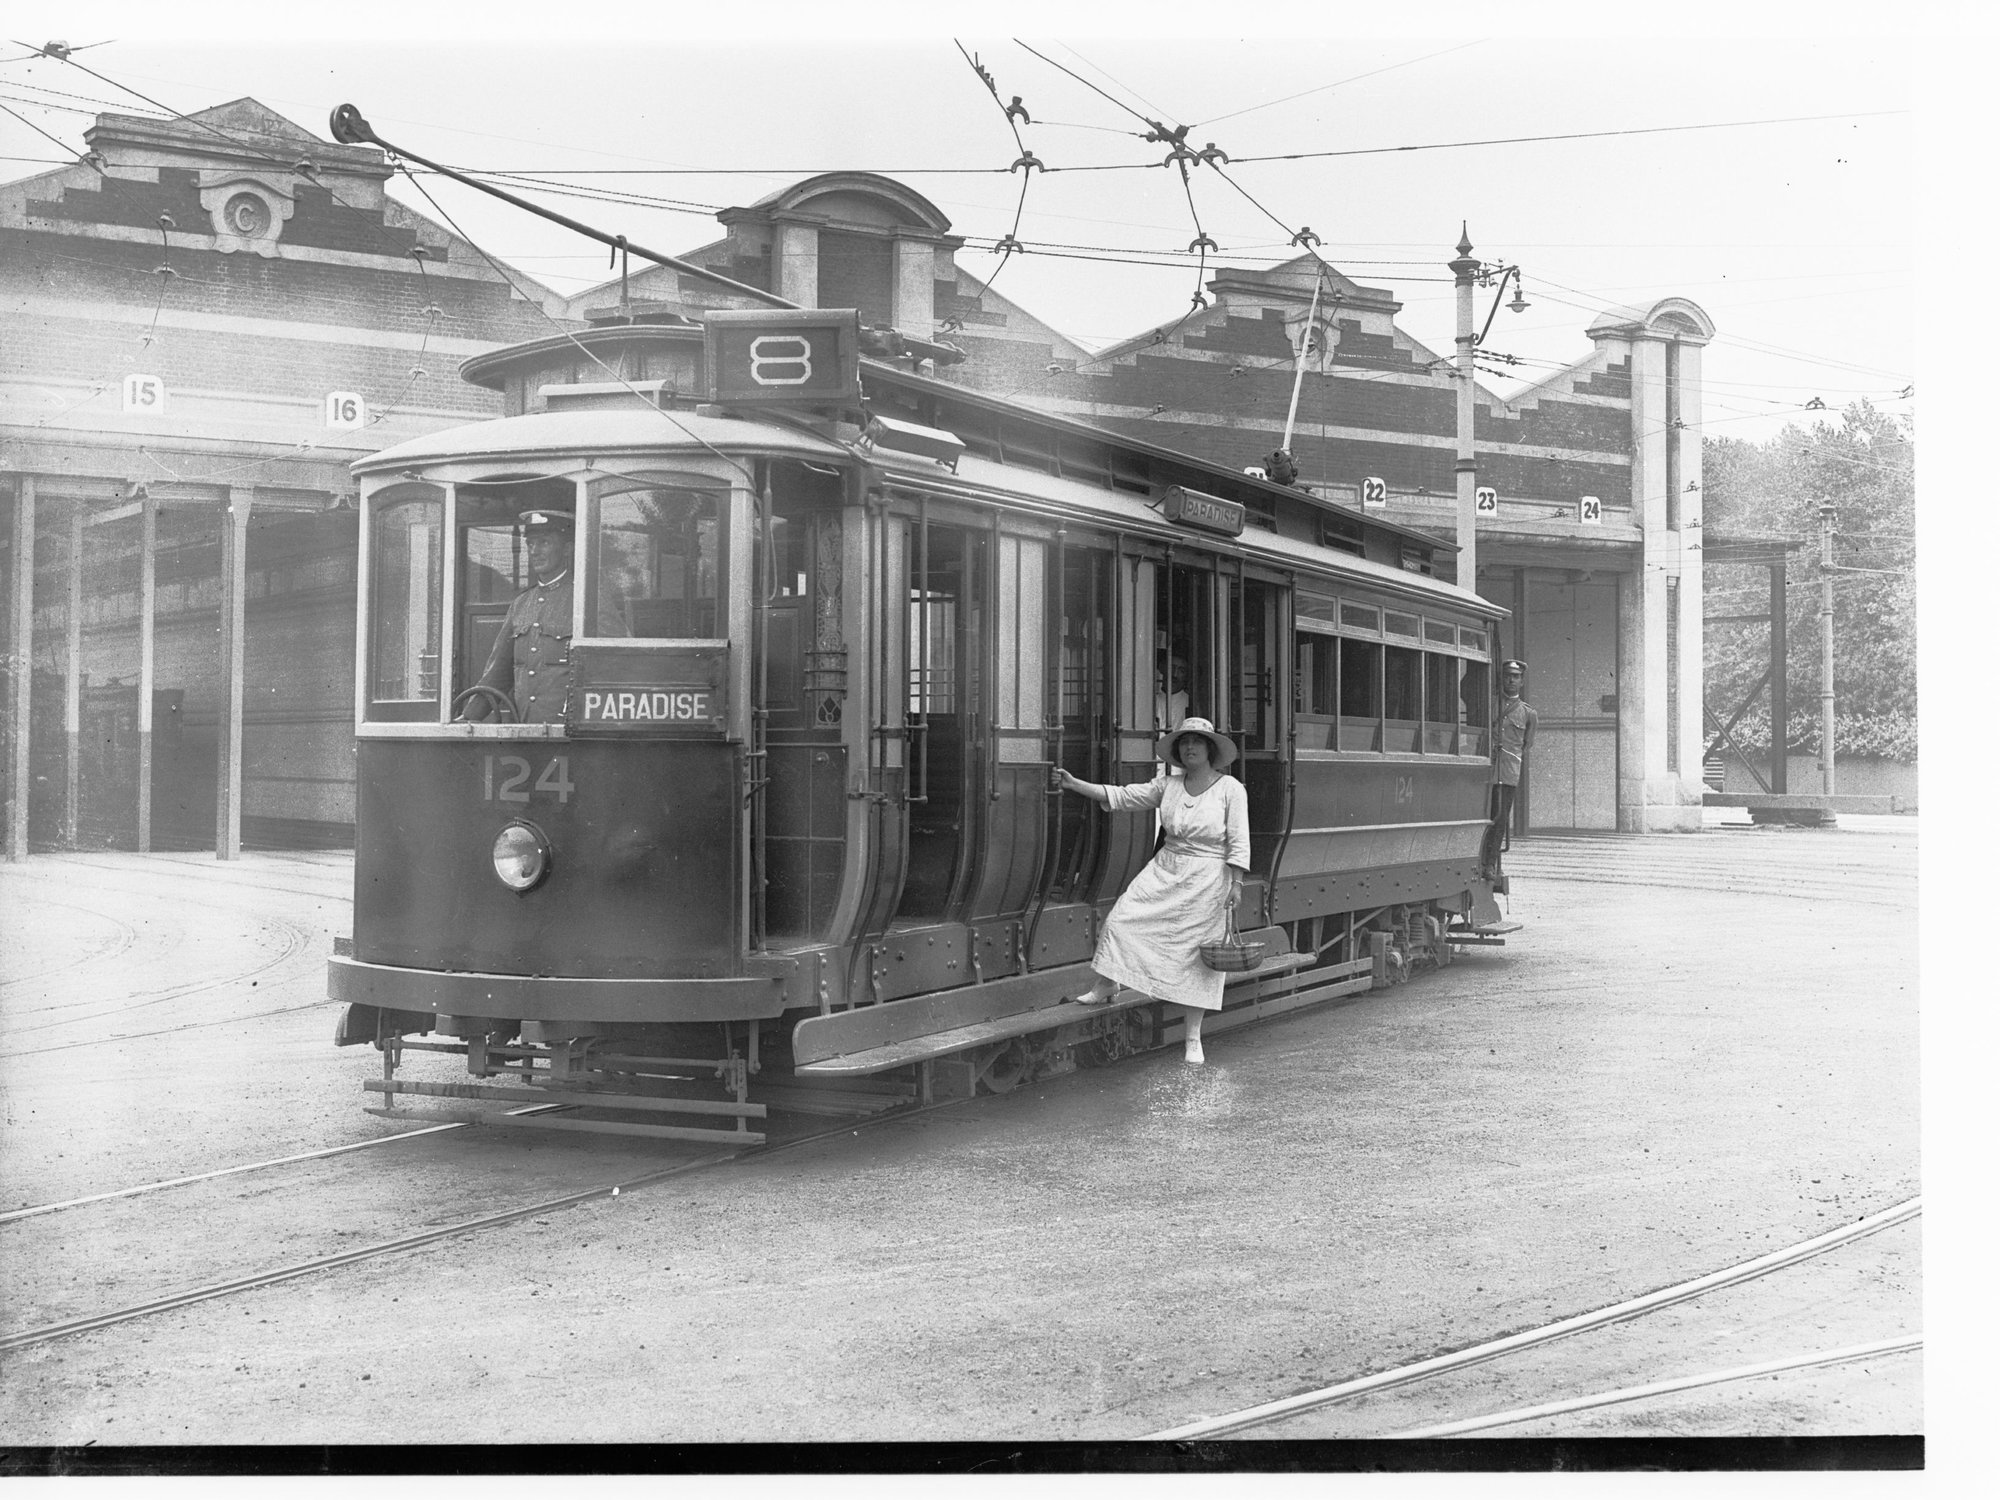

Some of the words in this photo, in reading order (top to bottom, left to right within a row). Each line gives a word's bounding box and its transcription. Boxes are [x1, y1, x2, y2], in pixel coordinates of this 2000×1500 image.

[235, 203, 257, 232] C
[750, 335, 812, 385] 8
[131, 380, 156, 406] 15
[333, 397, 357, 422] 16
[1366, 482, 1384, 502] 22
[1478, 492, 1495, 510] 23
[1186, 501, 1237, 526] PARADISE
[1584, 501, 1600, 519] 24
[584, 693, 709, 720] PARADISE
[484, 755, 574, 803] 124
[1395, 776, 1413, 803] 124
